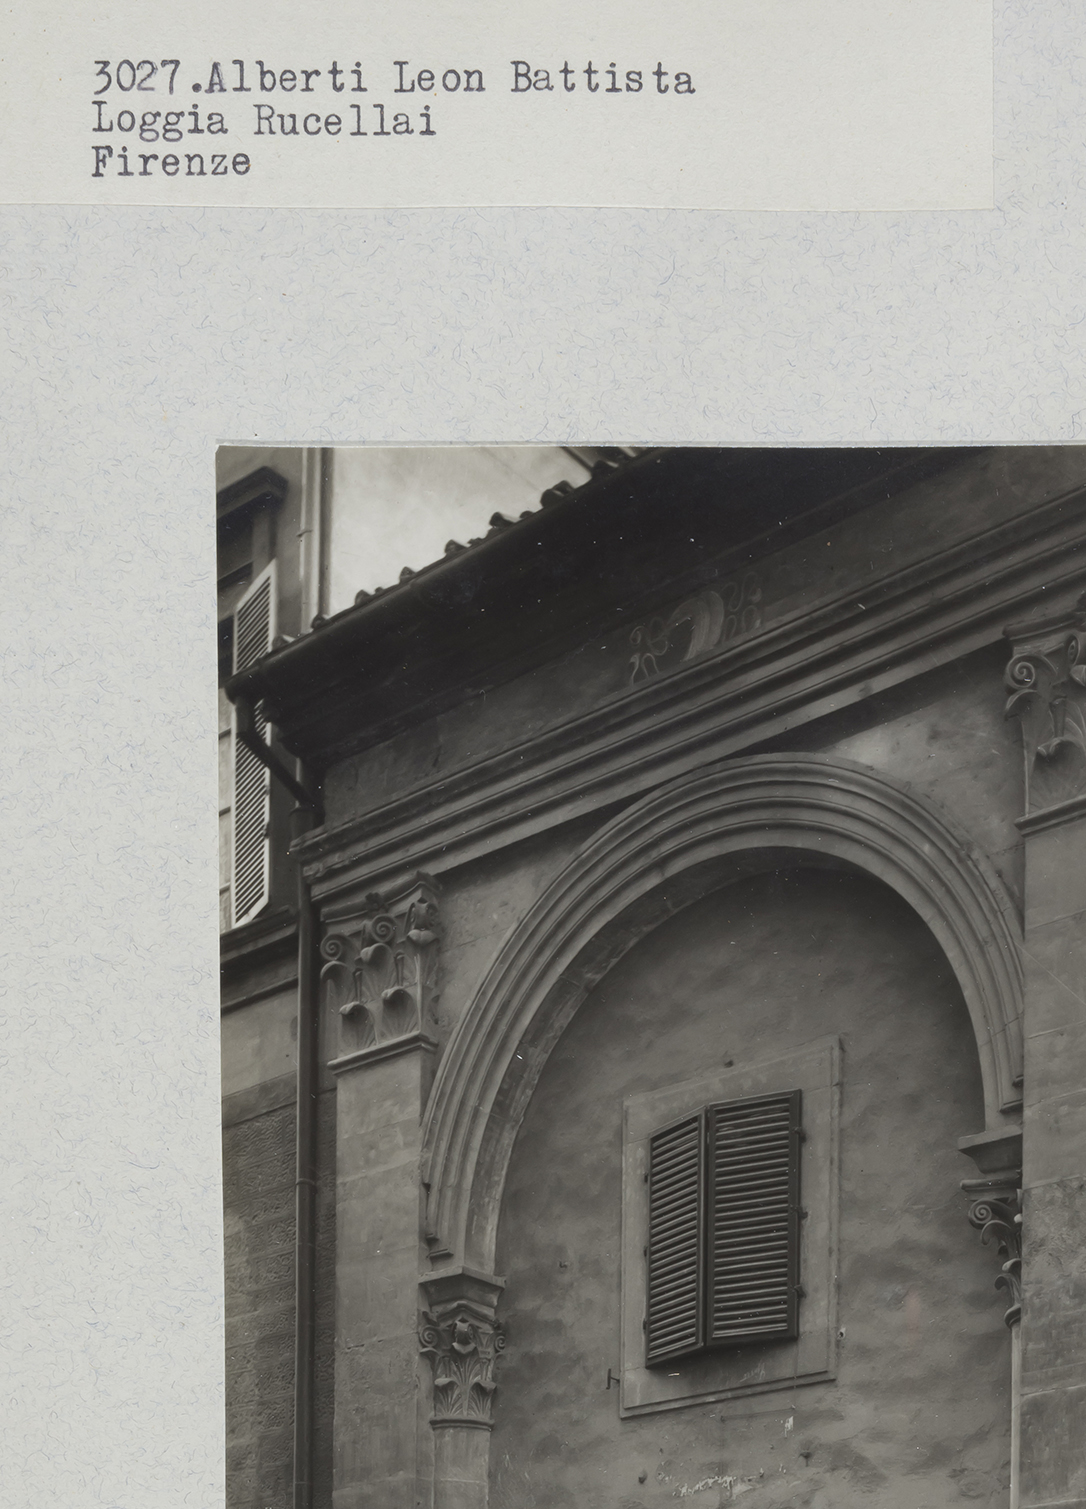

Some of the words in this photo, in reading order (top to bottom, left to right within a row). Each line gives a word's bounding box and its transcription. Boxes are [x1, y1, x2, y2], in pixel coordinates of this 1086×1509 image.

[394, 61, 486, 94] Leon
[511, 61, 696, 95] Battista
[92, 102, 228, 143] Loggia
[253, 104, 436, 136] Rucellai
[92, 146, 251, 178] Firenze
